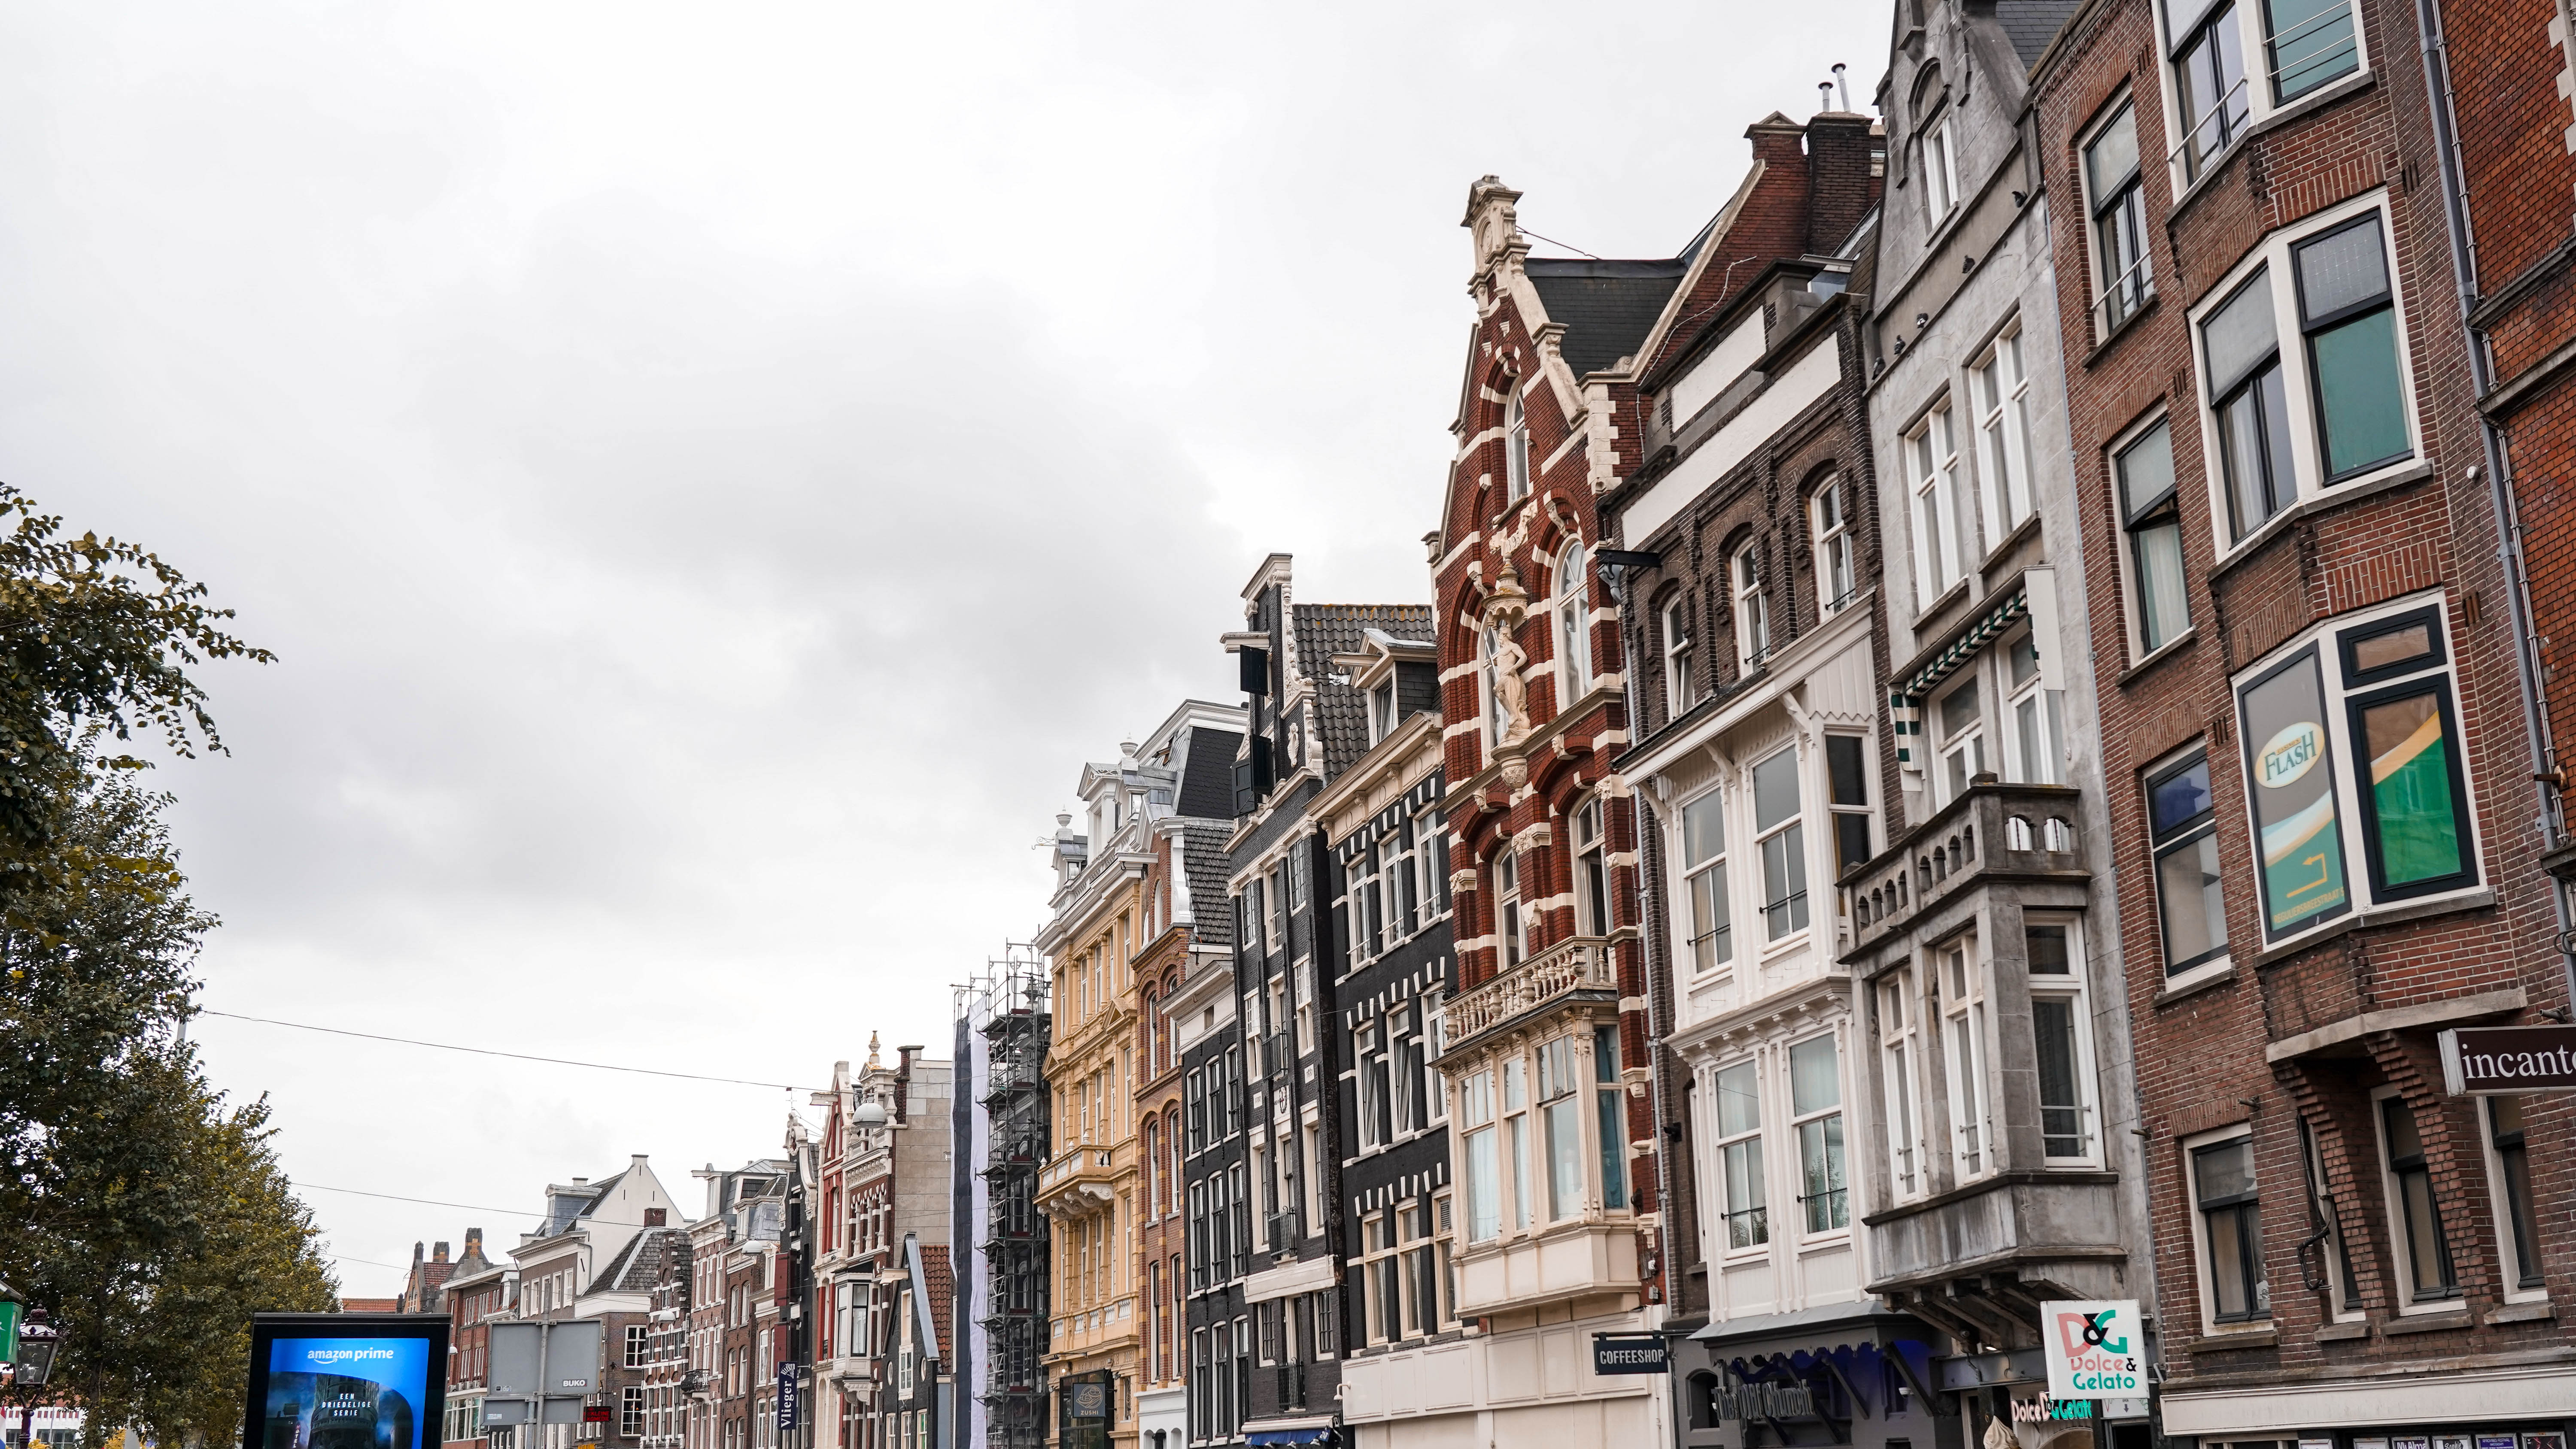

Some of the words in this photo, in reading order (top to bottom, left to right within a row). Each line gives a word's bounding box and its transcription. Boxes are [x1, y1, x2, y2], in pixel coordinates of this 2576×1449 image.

[2264, 731, 2317, 781] FLASH
[2462, 1043, 2576, 1079] incant
[2057, 1310, 2128, 1358] D&G
[307, 1350, 352, 1360] amazon
[354, 1347, 394, 1361] prime
[1600, 1349, 1665, 1365] COFFEESHOP
[2073, 1372, 2135, 1390] Gelato
[781, 1380, 794, 1428] Vlieger
[1711, 1387, 1738, 1420] The
[2011, 1399, 2041, 1422] Dolce
